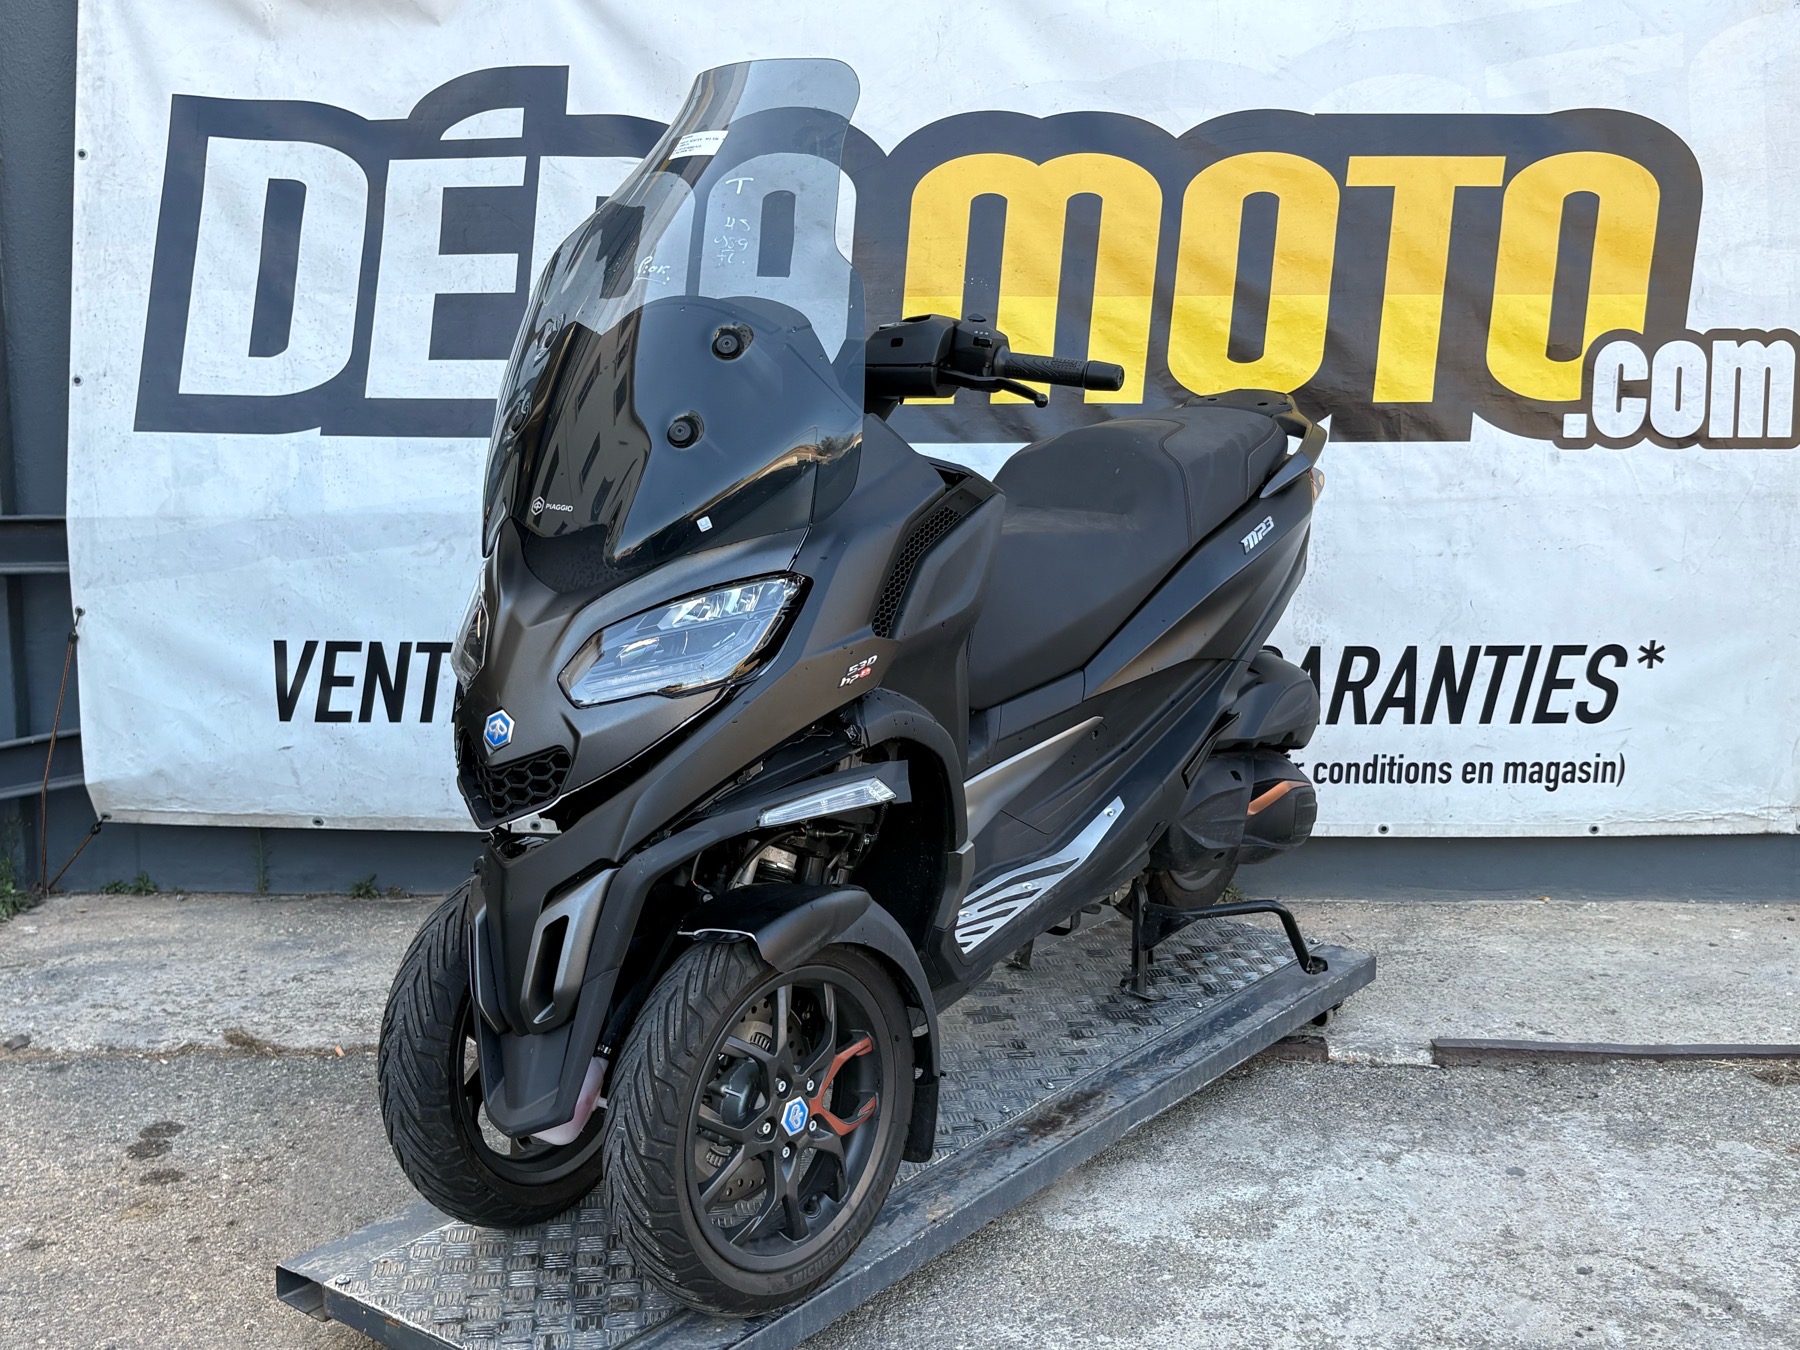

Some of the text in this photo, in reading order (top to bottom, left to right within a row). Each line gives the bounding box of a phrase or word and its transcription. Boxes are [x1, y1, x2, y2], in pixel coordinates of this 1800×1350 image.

[545, 503, 574, 513] PIAGGIO
[1240, 515, 1275, 554] MP3
[273, 640, 460, 724] VENT
[847, 654, 878, 676] 530
[1313, 754, 1452, 785] conditions
[1461, 761, 1493, 784] en
[1502, 752, 1626, 792] magasin)
[792, 1236, 847, 1285] MICHELIN
